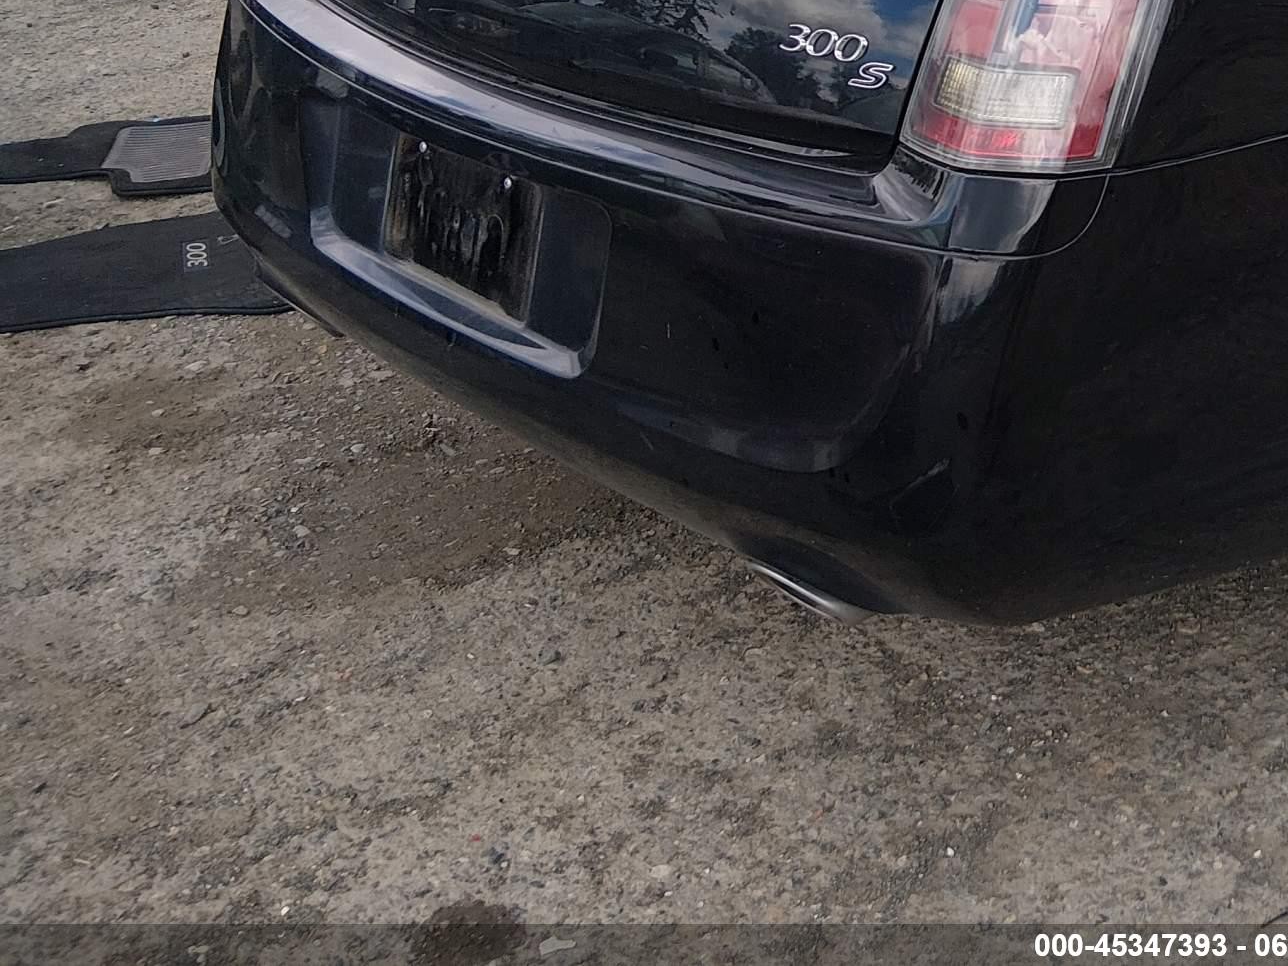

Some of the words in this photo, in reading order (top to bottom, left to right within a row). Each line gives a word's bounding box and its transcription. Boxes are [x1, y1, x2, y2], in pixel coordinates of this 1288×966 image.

[779, 23, 868, 62] 300
[848, 62, 894, 89] S
[186, 242, 208, 267] 300
